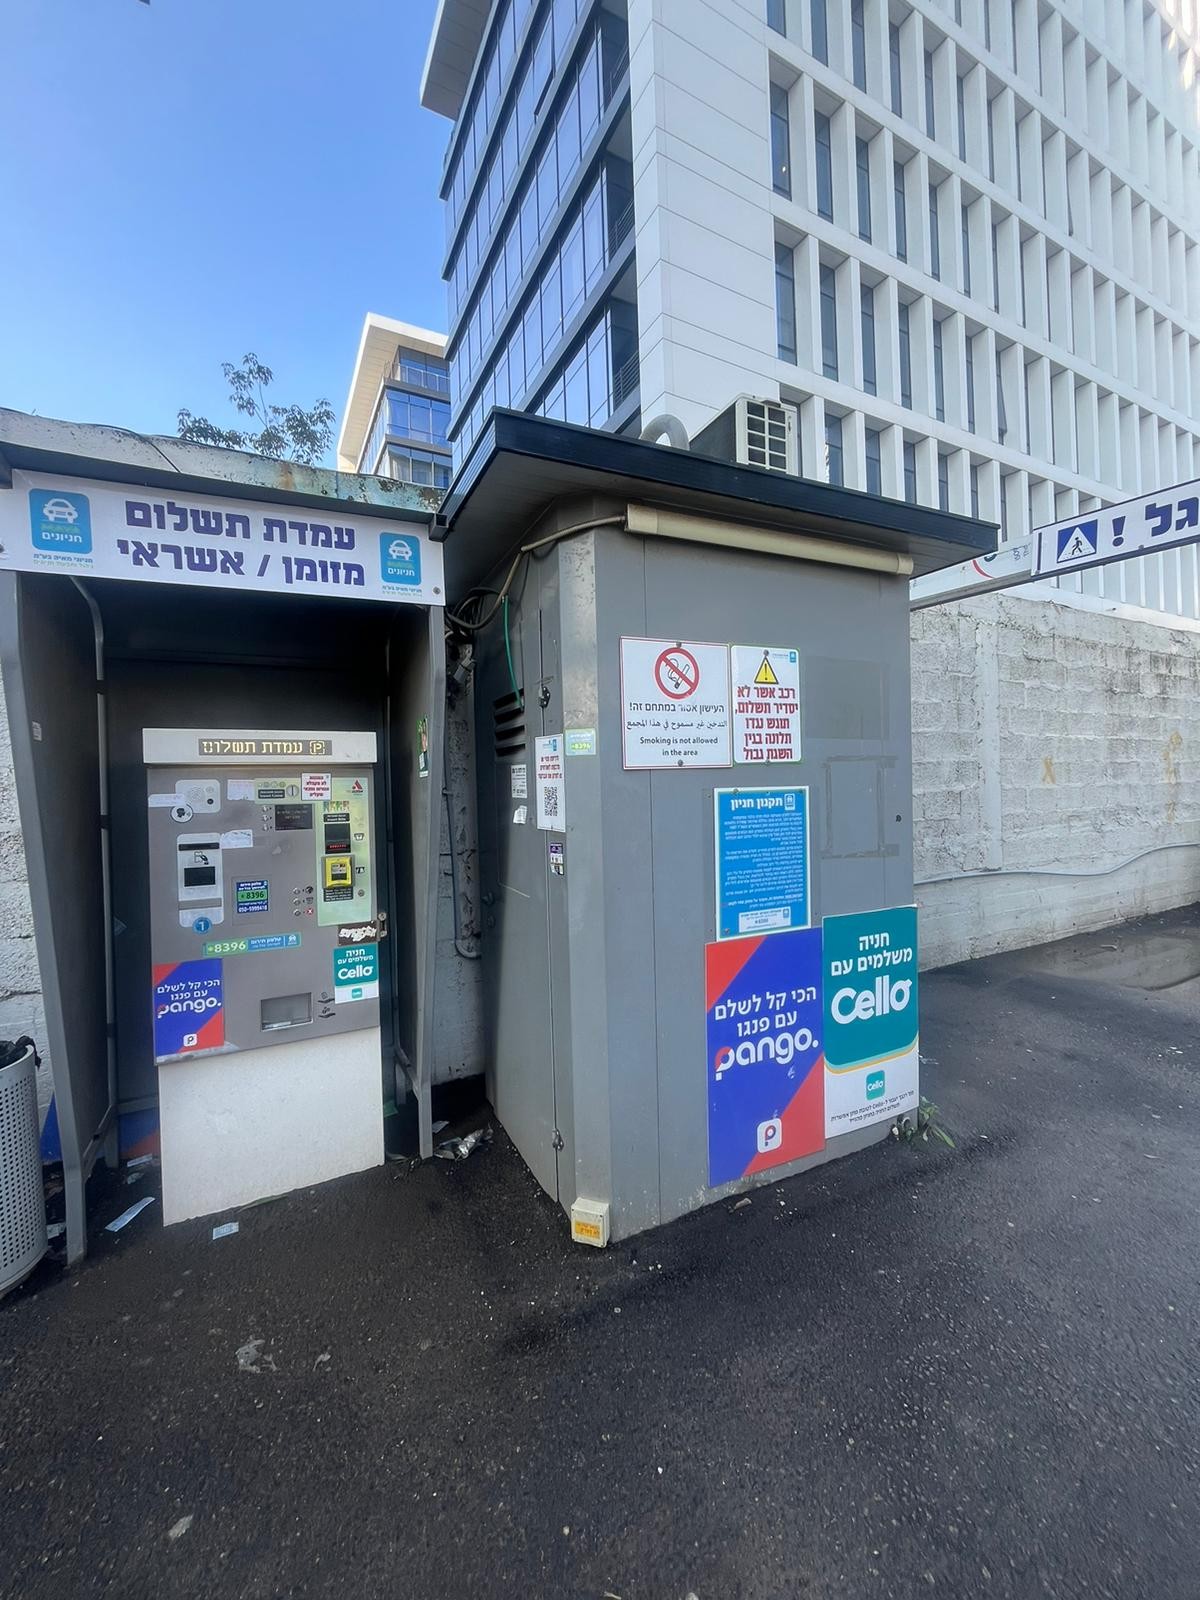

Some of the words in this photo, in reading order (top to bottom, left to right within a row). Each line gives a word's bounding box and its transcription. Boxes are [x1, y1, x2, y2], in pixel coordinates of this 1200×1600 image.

[125, 500, 251, 539] תשלום
[42, 532, 82, 543] חניונים
[263, 517, 355, 550] עמדת
[117, 540, 245, 576] אשראי
[281, 556, 365, 586] מזומן
[388, 568, 415, 577] חניונים
[737, 684, 750, 697] לא
[753, 686, 775, 698] אשר
[778, 687, 796, 699] רכב
[645, 702, 676, 712] במתחם
[699, 703, 724, 715] העישון
[773, 703, 798, 714] יסדיר
[746, 718, 764, 729] נגדו
[768, 718, 790, 729] תוגש
[640, 736, 671, 747] Smoking
[672, 737, 678, 745] is
[679, 737, 691, 745] not
[692, 737, 718, 745] allowed
[744, 733, 763, 745] בגין
[765, 731, 792, 744] תלונה
[202, 740, 256, 753] תשלום
[262, 742, 303, 753] עמדת
[743, 746, 764, 760] גבול
[766, 748, 793, 760] השגת
[731, 798, 754, 811] חניון
[756, 796, 783, 809] תקנון
[859, 932, 890, 952] חניה
[346, 949, 365, 958] חניה
[348, 955, 374, 963] משלמים
[858, 947, 913, 972] משלמים
[337, 965, 374, 980] Cello
[831, 959, 853, 977] עם
[157, 983, 186, 994] לשלם
[188, 981, 201, 990] קל
[204, 979, 220, 987] הכי
[171, 992, 191, 1001] פנגו
[193, 990, 208, 998] עם
[791, 986, 817, 1003] הכי
[831, 974, 913, 1025] Cello
[766, 991, 786, 1010] קל
[714, 995, 762, 1021] לשלם
[775, 1010, 797, 1029] עם
[737, 1017, 770, 1038] פנגו
[867, 1080, 884, 1091] Cello
